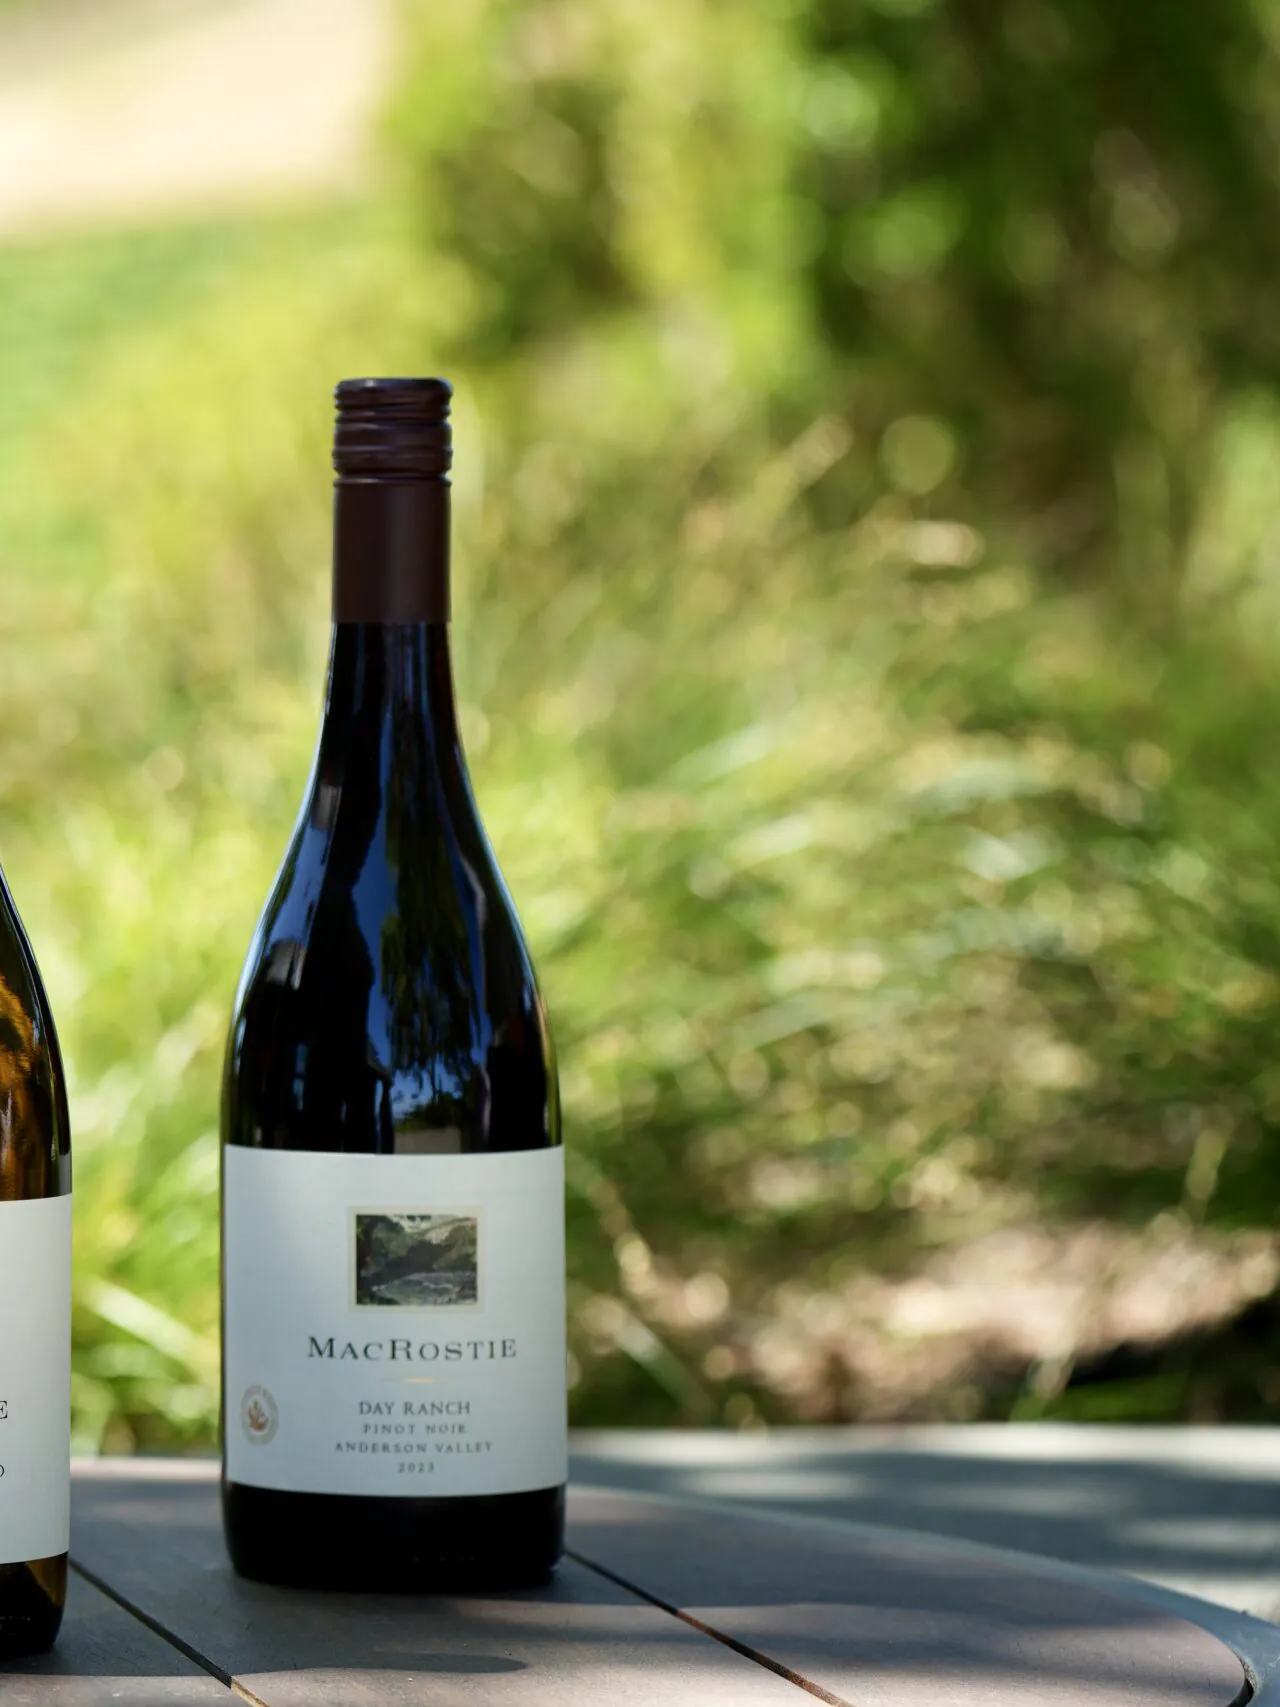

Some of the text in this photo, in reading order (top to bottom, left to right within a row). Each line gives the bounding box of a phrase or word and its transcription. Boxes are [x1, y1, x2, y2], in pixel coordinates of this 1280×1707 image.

[358, 1400, 472, 1417] DAY RANCH
[362, 1422, 467, 1435] PINOT NOIR
[334, 1440, 494, 1454] ANDERSON VALLEY
[397, 1461, 436, 1474] 2023
